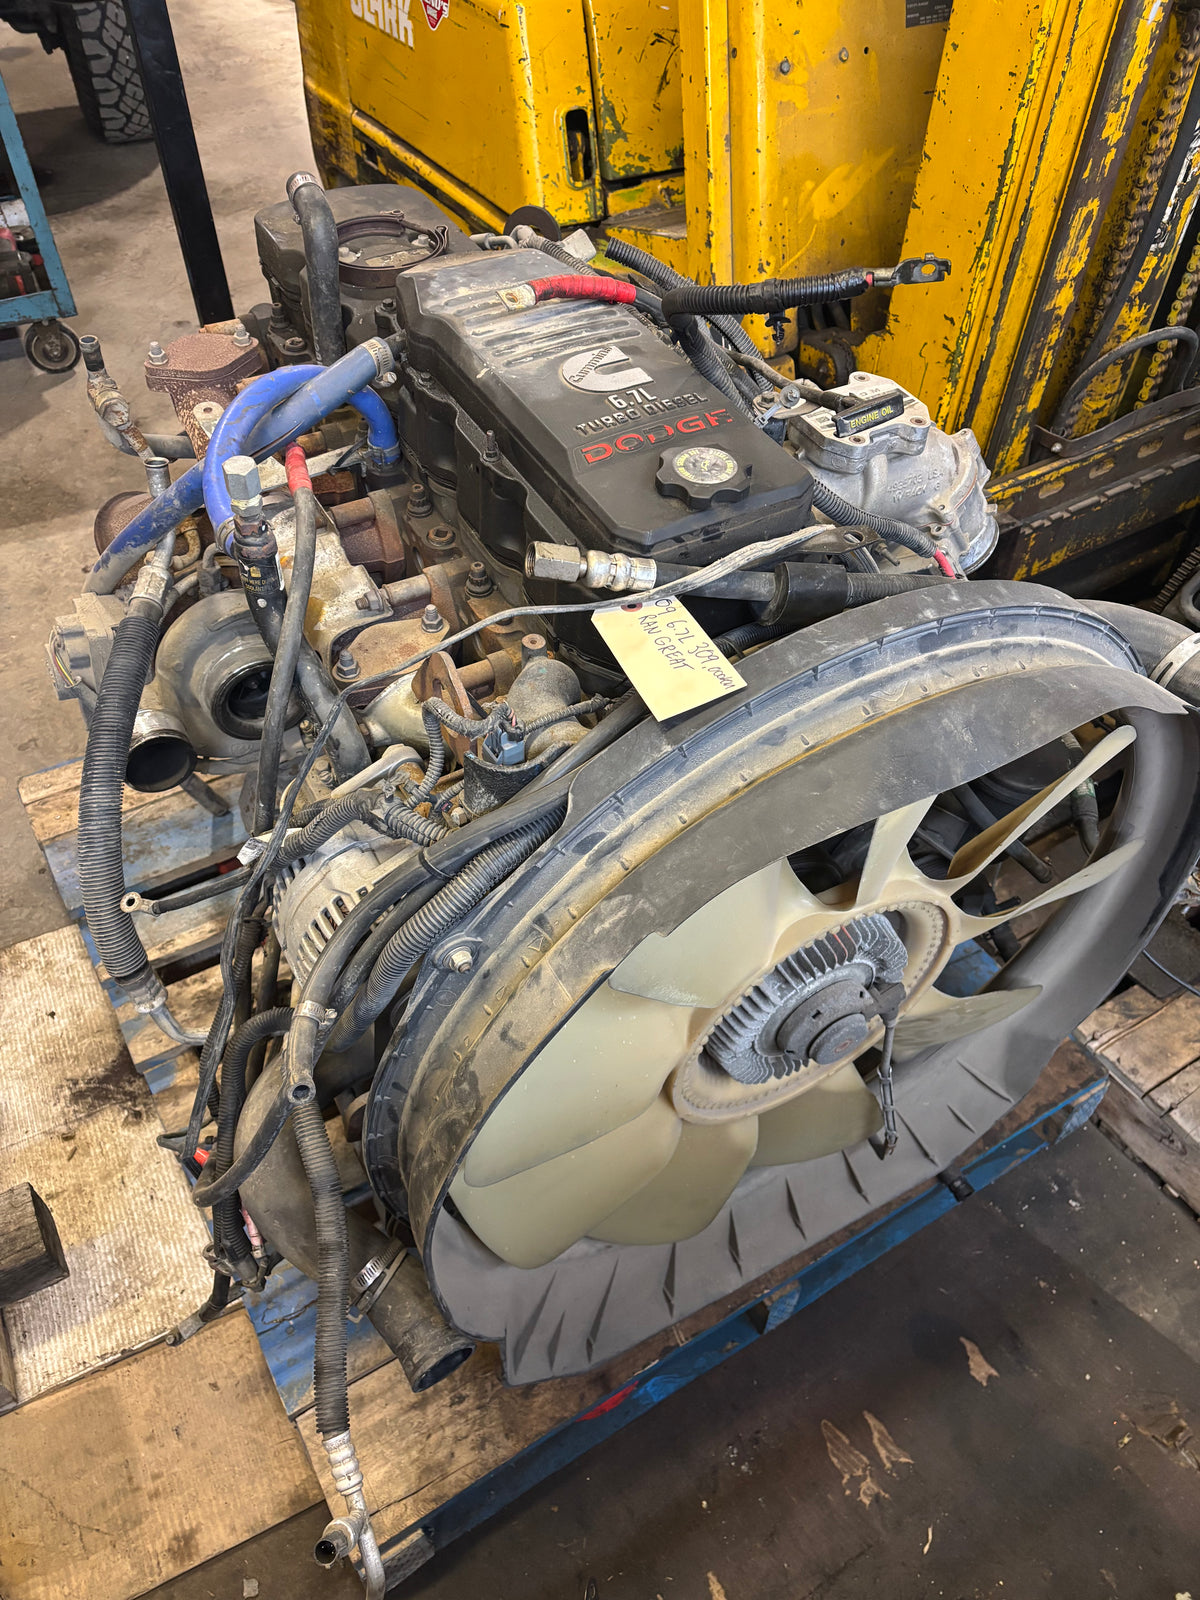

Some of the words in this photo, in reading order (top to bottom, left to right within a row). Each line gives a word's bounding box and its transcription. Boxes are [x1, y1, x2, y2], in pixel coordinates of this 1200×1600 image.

[575, 408, 641, 435] TURBO
[643, 392, 709, 416] DIESEL
[607, 387, 657, 409] 6.7L
[849, 411, 879, 429] ENGINE
[881, 405, 894, 417] OIL
[581, 408, 733, 464] DODGE
[638, 614, 662, 635] RAN
[654, 636, 695, 670] GREAT
[667, 620, 695, 644] 6.7L
